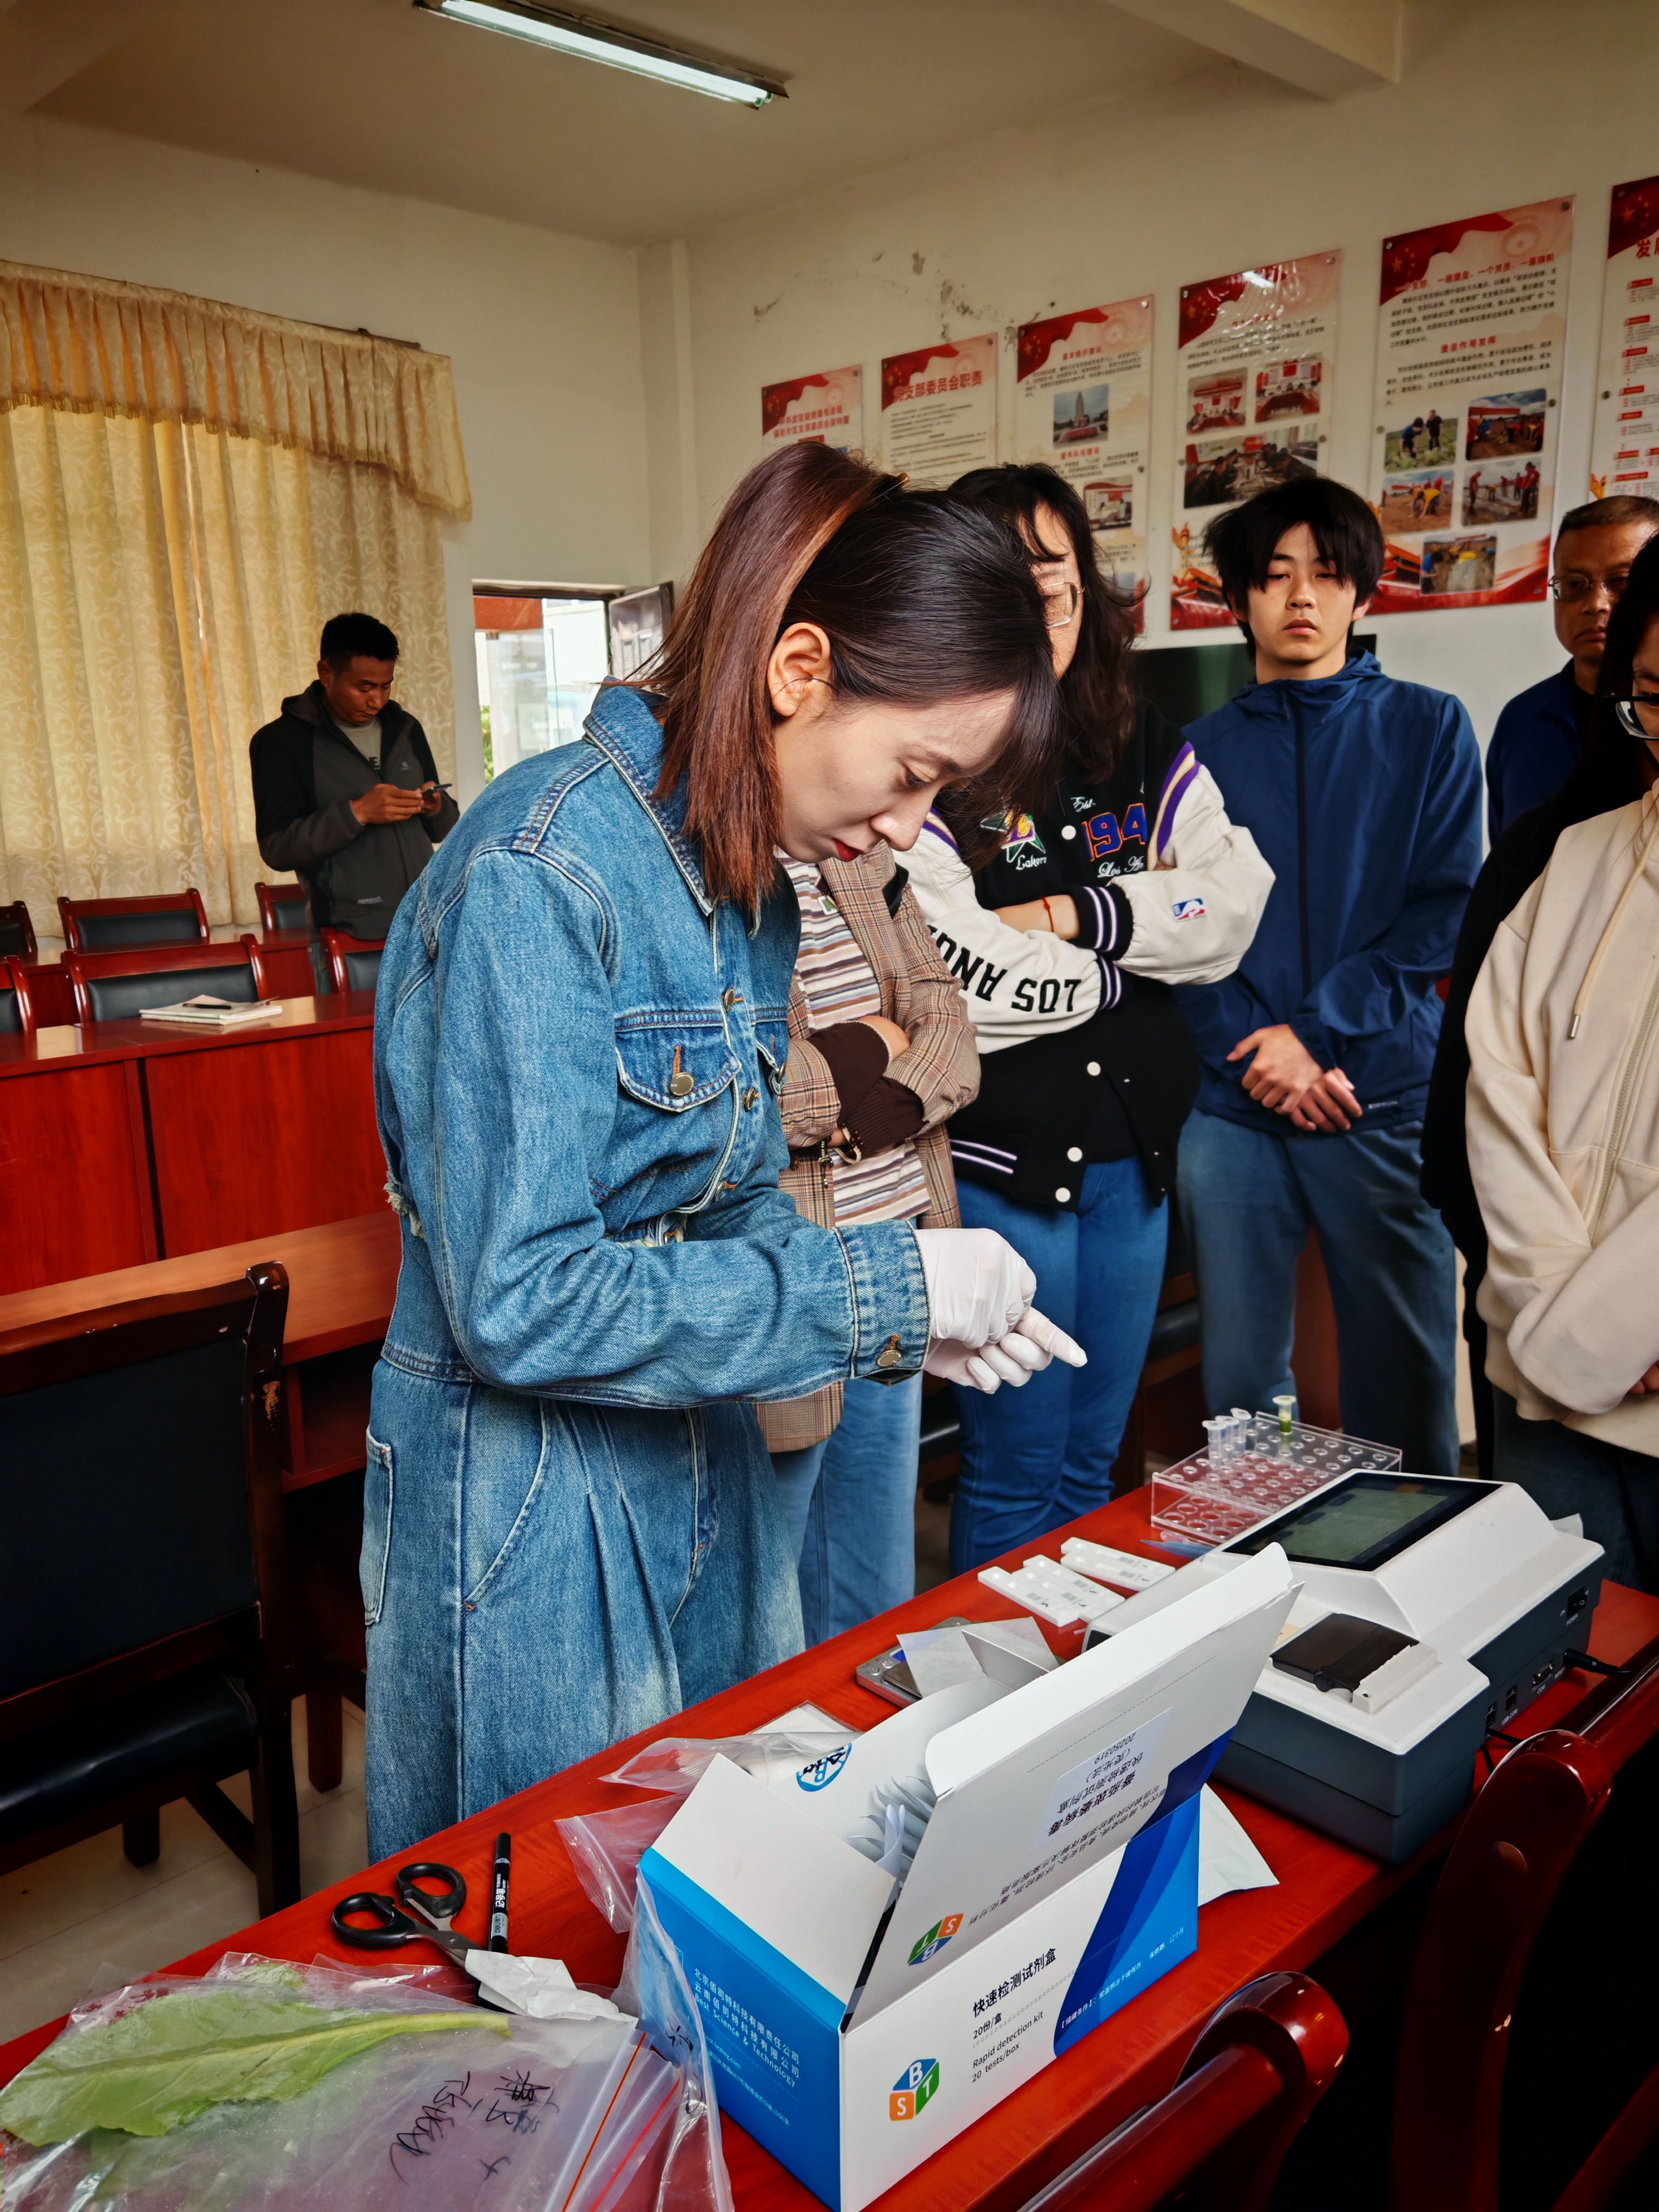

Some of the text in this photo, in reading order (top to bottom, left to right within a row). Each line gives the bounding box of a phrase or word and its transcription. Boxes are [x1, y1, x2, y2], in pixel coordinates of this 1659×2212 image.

[893, 370, 983, 402] 党支部委员会职责
[1016, 854, 1047, 871] Lakers
[1011, 978, 1082, 1013] LOS
[1094, 1732, 1136, 1764] 20250319
[495, 1888, 507, 1908] 记号笔
[973, 1947, 1056, 2018] 快速检测试剂盒
[694, 1967, 799, 2064] 北京佰司特科技有限责任公司
[695, 1981, 799, 2079] 云南佰司特科技有限公司
[973, 2012, 1002, 2040] 20份/盒
[694, 1993, 795, 2087] Best Science & Technology
[973, 2011, 1044, 2069] Rapid detection kit
[972, 2042, 1020, 2083] 20 tests/box
